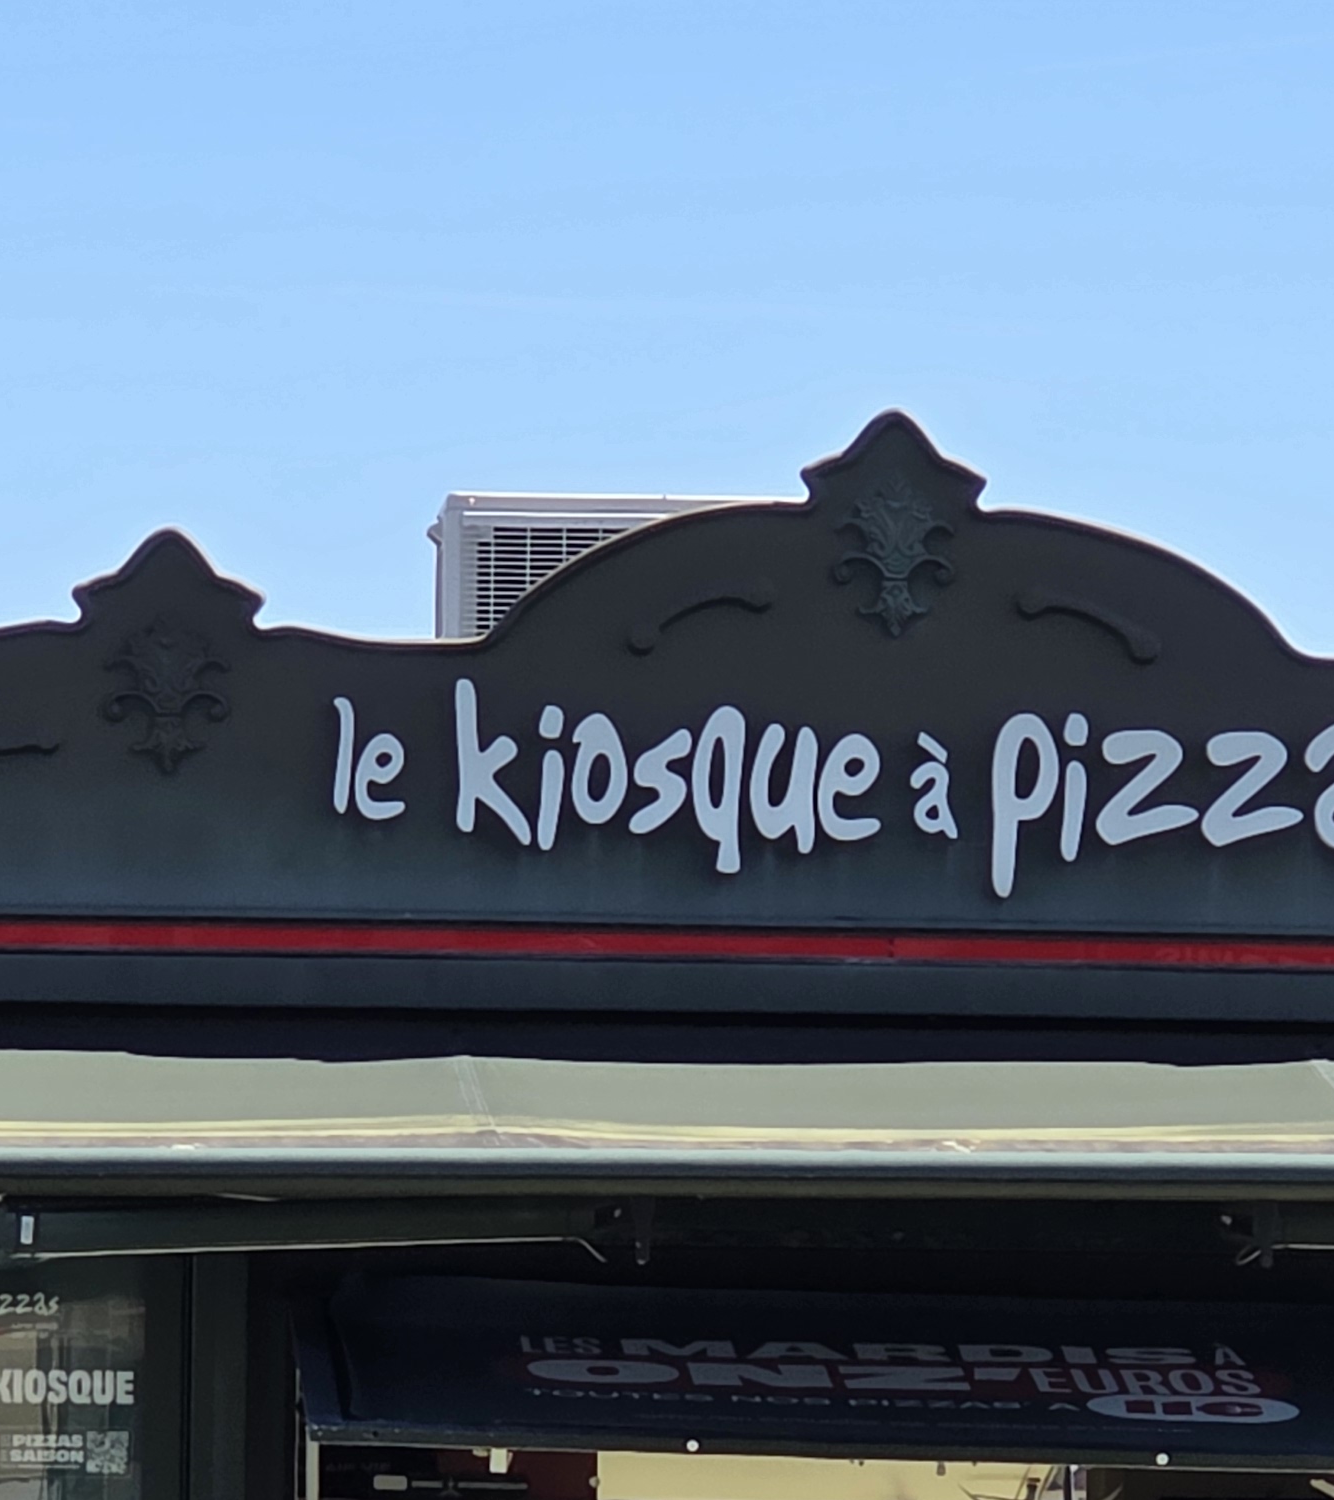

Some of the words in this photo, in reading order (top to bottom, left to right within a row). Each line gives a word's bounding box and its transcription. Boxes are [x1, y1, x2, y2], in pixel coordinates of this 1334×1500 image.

[333, 697, 406, 821] le
[455, 677, 882, 873] kiosque
[911, 733, 959, 840] à
[519, 1335, 602, 1354] LES
[620, 1337, 1197, 1365] MARDIS
[12, 1434, 83, 1448] PIZZAS
